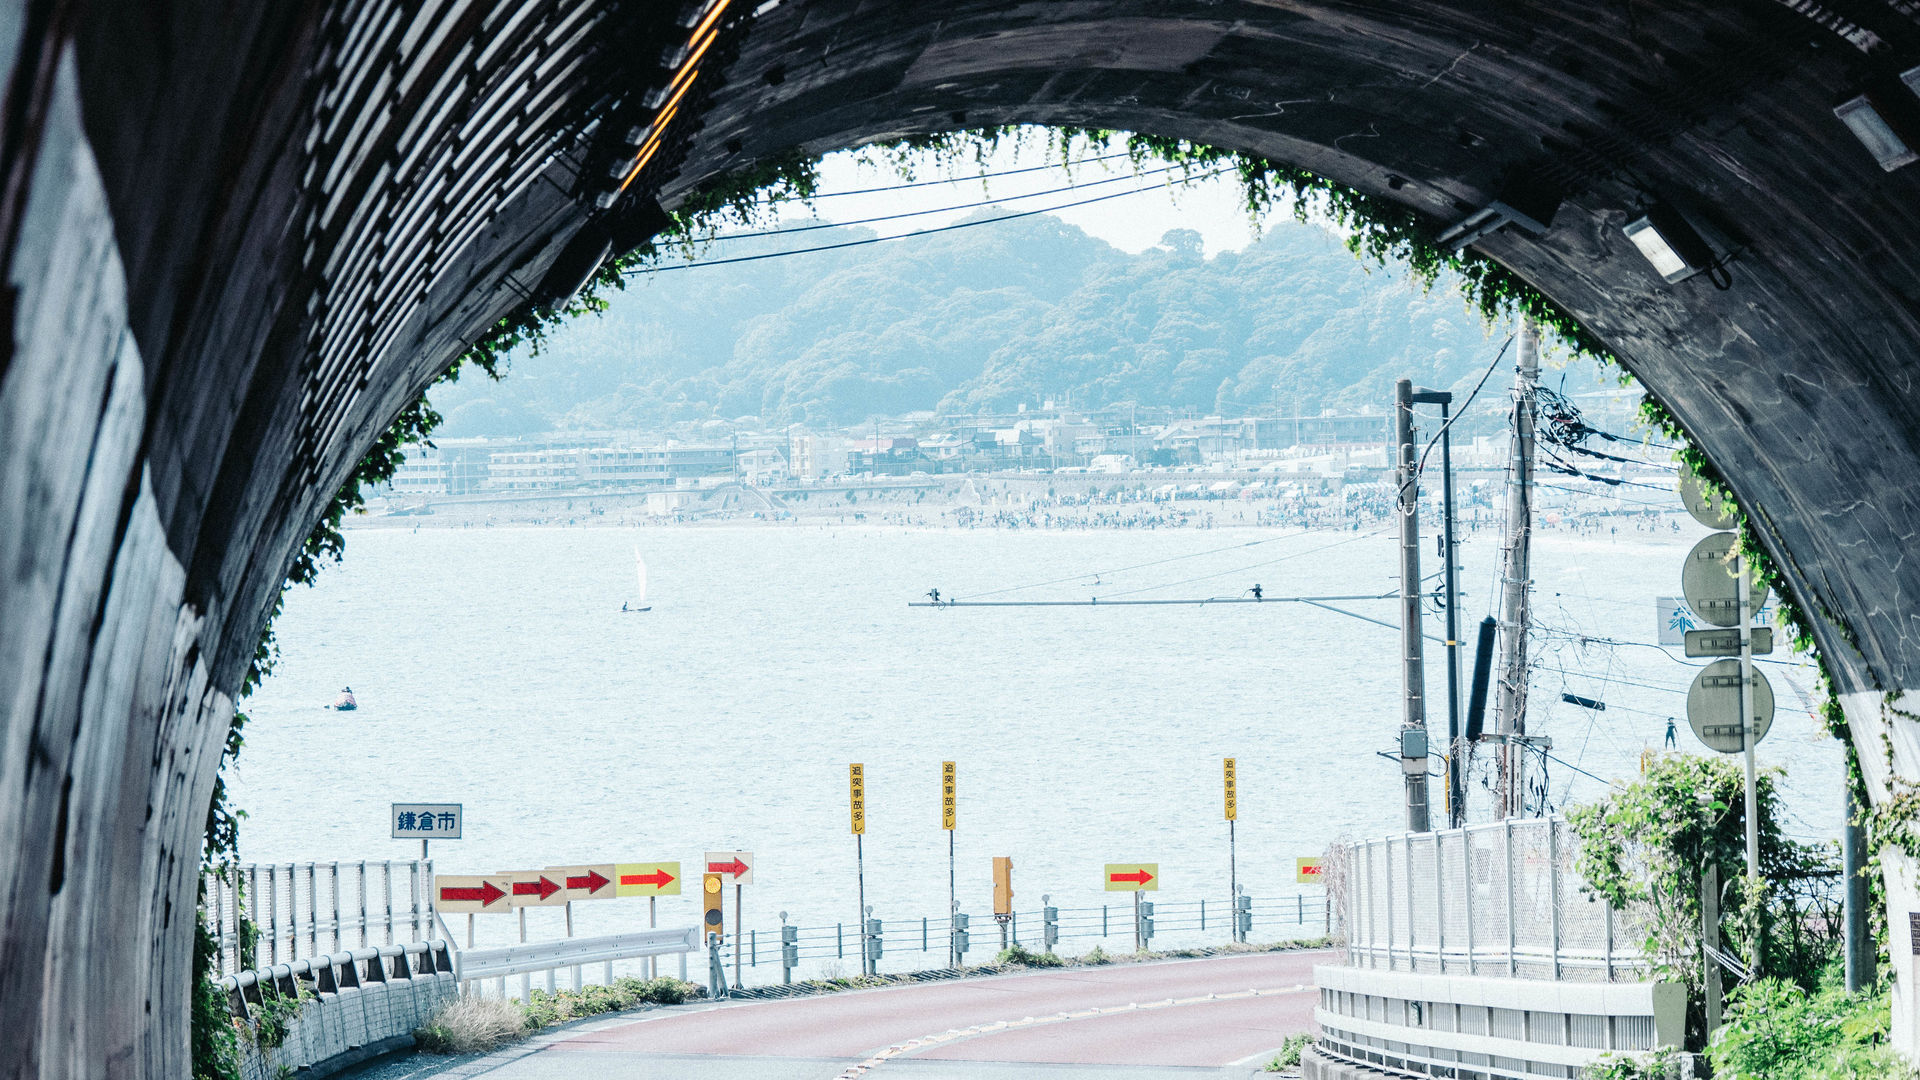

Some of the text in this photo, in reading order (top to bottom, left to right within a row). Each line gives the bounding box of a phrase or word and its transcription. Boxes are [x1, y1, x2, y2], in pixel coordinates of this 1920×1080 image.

[852, 766, 863, 832] 追突事故多し
[945, 764, 954, 828] 追突事故多し
[1226, 760, 1235, 818] 追突事故多し
[397, 811, 456, 831] 鎌倉市
